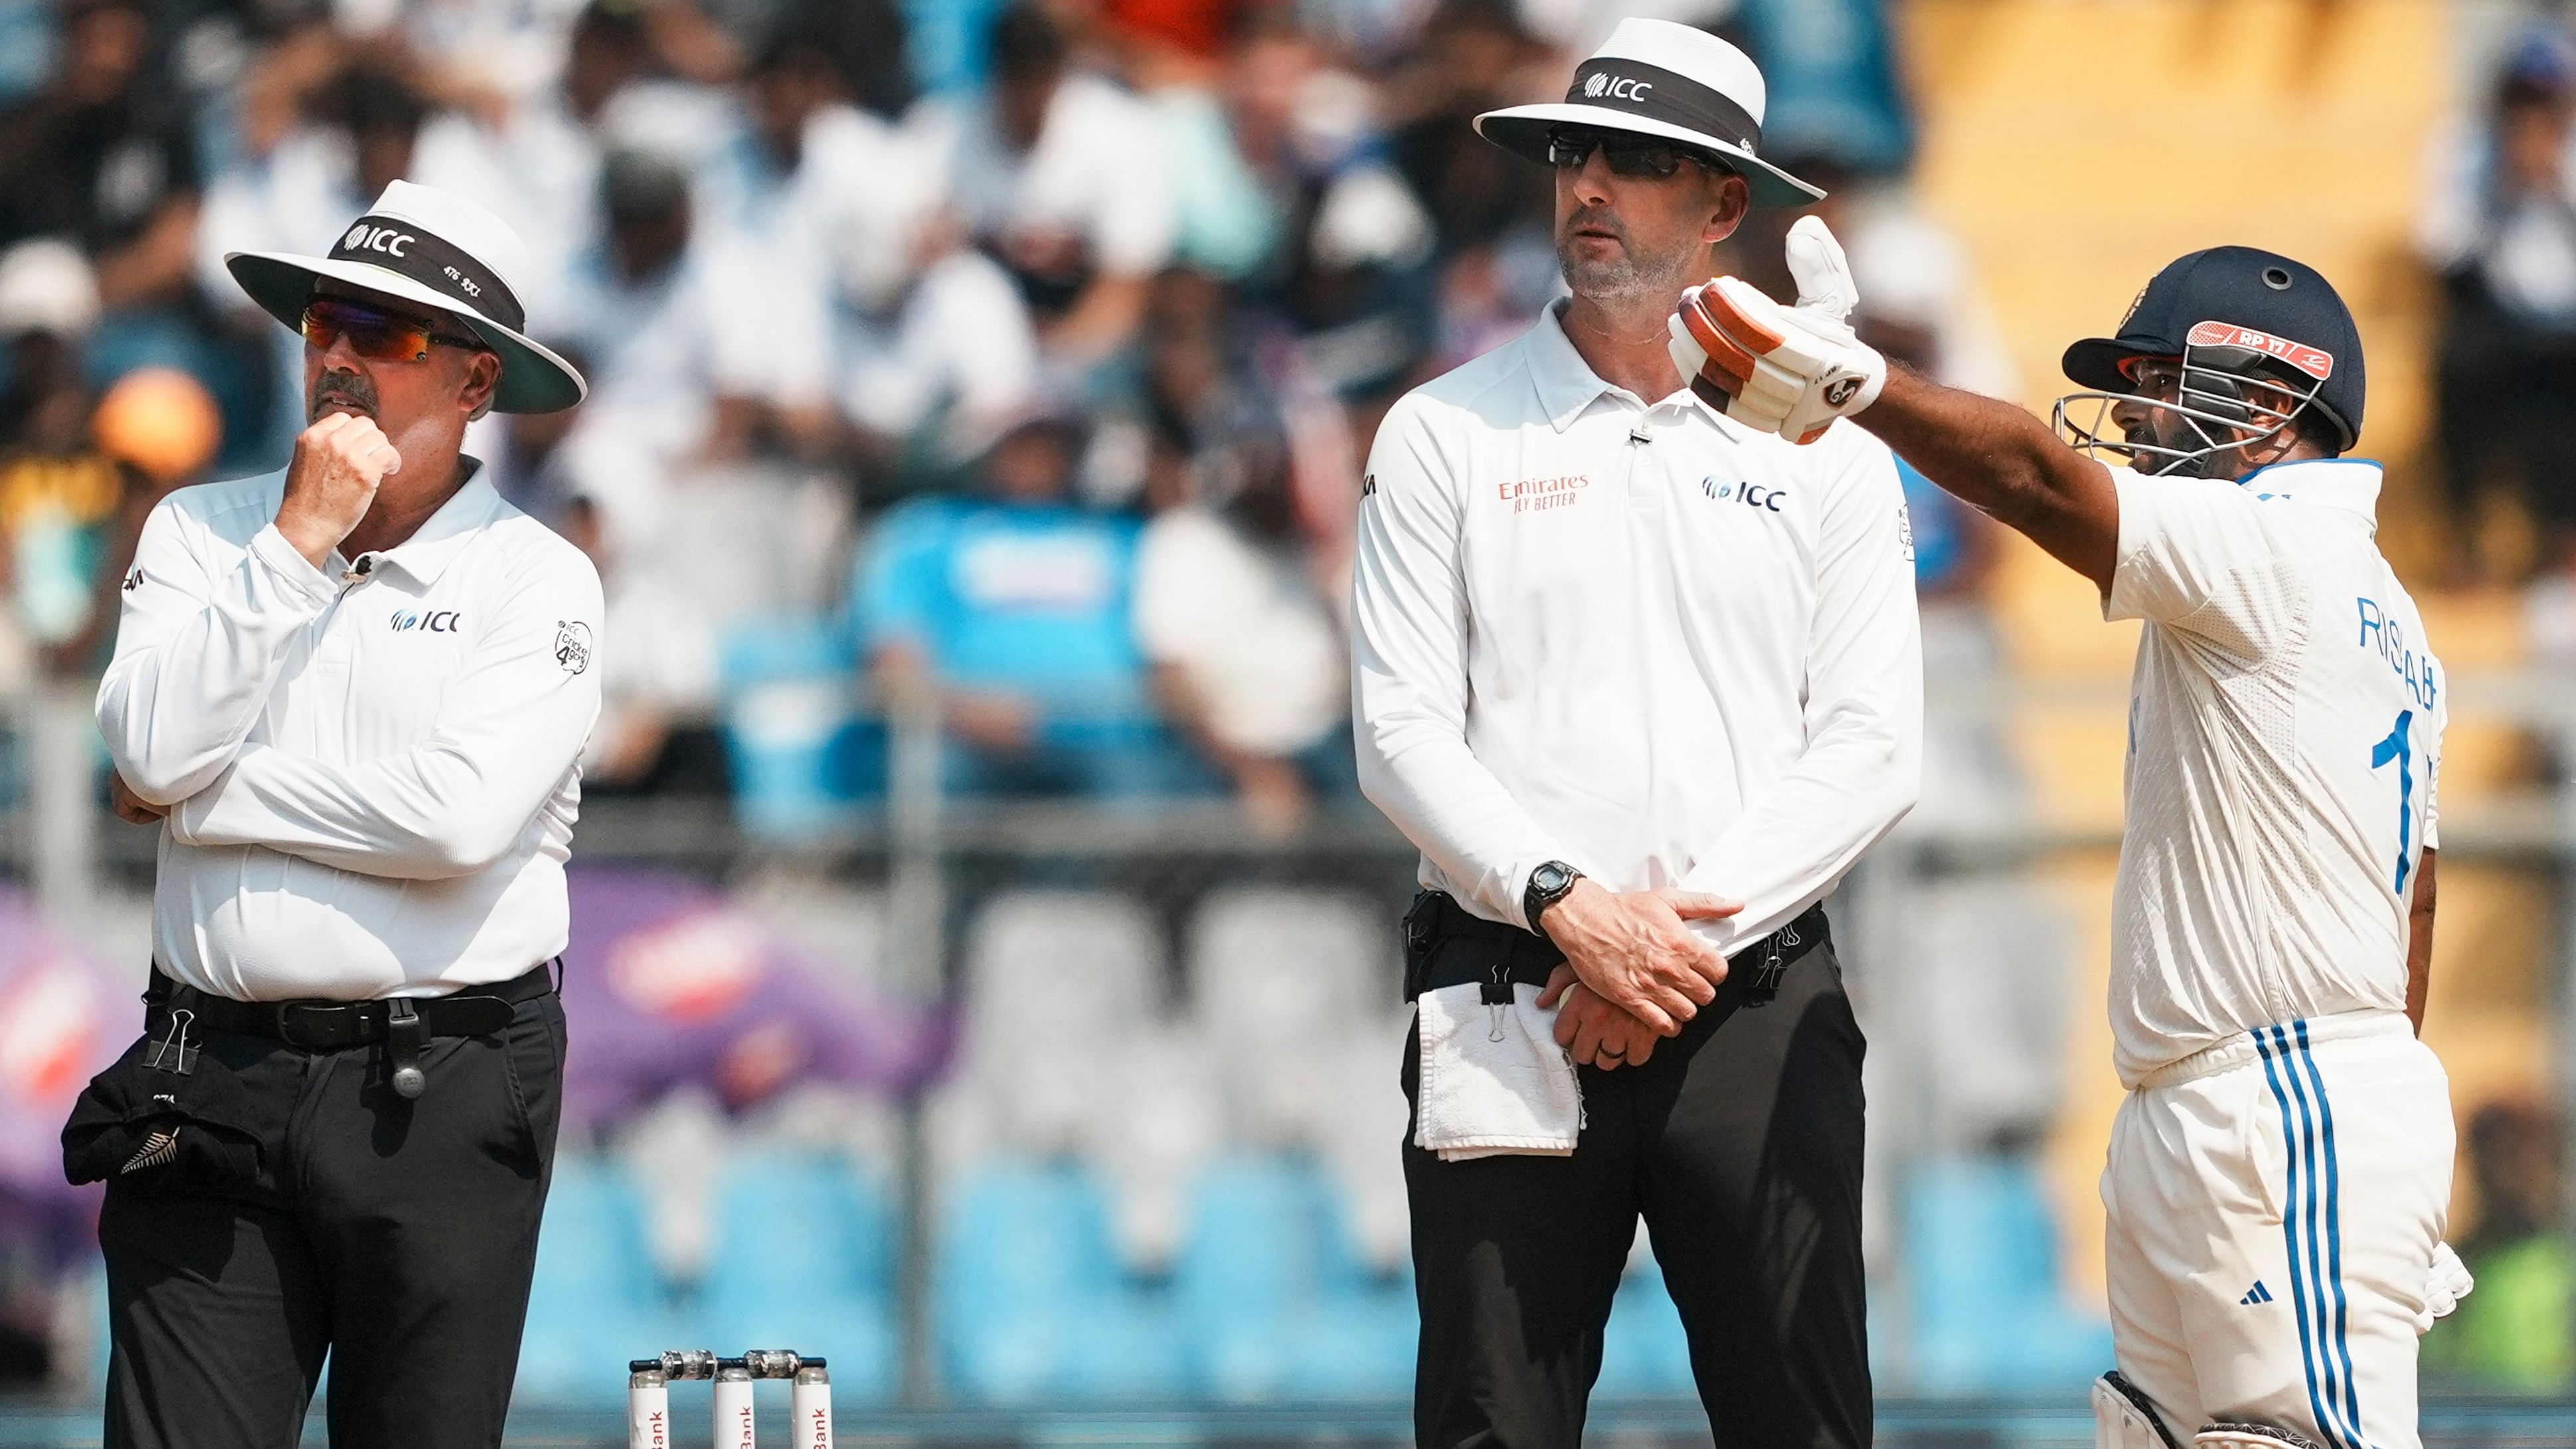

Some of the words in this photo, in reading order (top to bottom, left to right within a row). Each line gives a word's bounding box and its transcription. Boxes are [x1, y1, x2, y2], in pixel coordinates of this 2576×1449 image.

[1605, 76, 1653, 102] ICC
[363, 227, 415, 258] ICC
[444, 266, 461, 280] 476
[2239, 332, 2265, 346] RP
[2268, 339, 2286, 354] 17
[1498, 474, 1589, 500] Emirates
[1736, 481, 1786, 512] ICC
[1534, 492, 1576, 511] BETTER
[556, 645, 570, 666] 4
[2371, 709, 2433, 895] 1
[649, 1411, 663, 1449] ank
